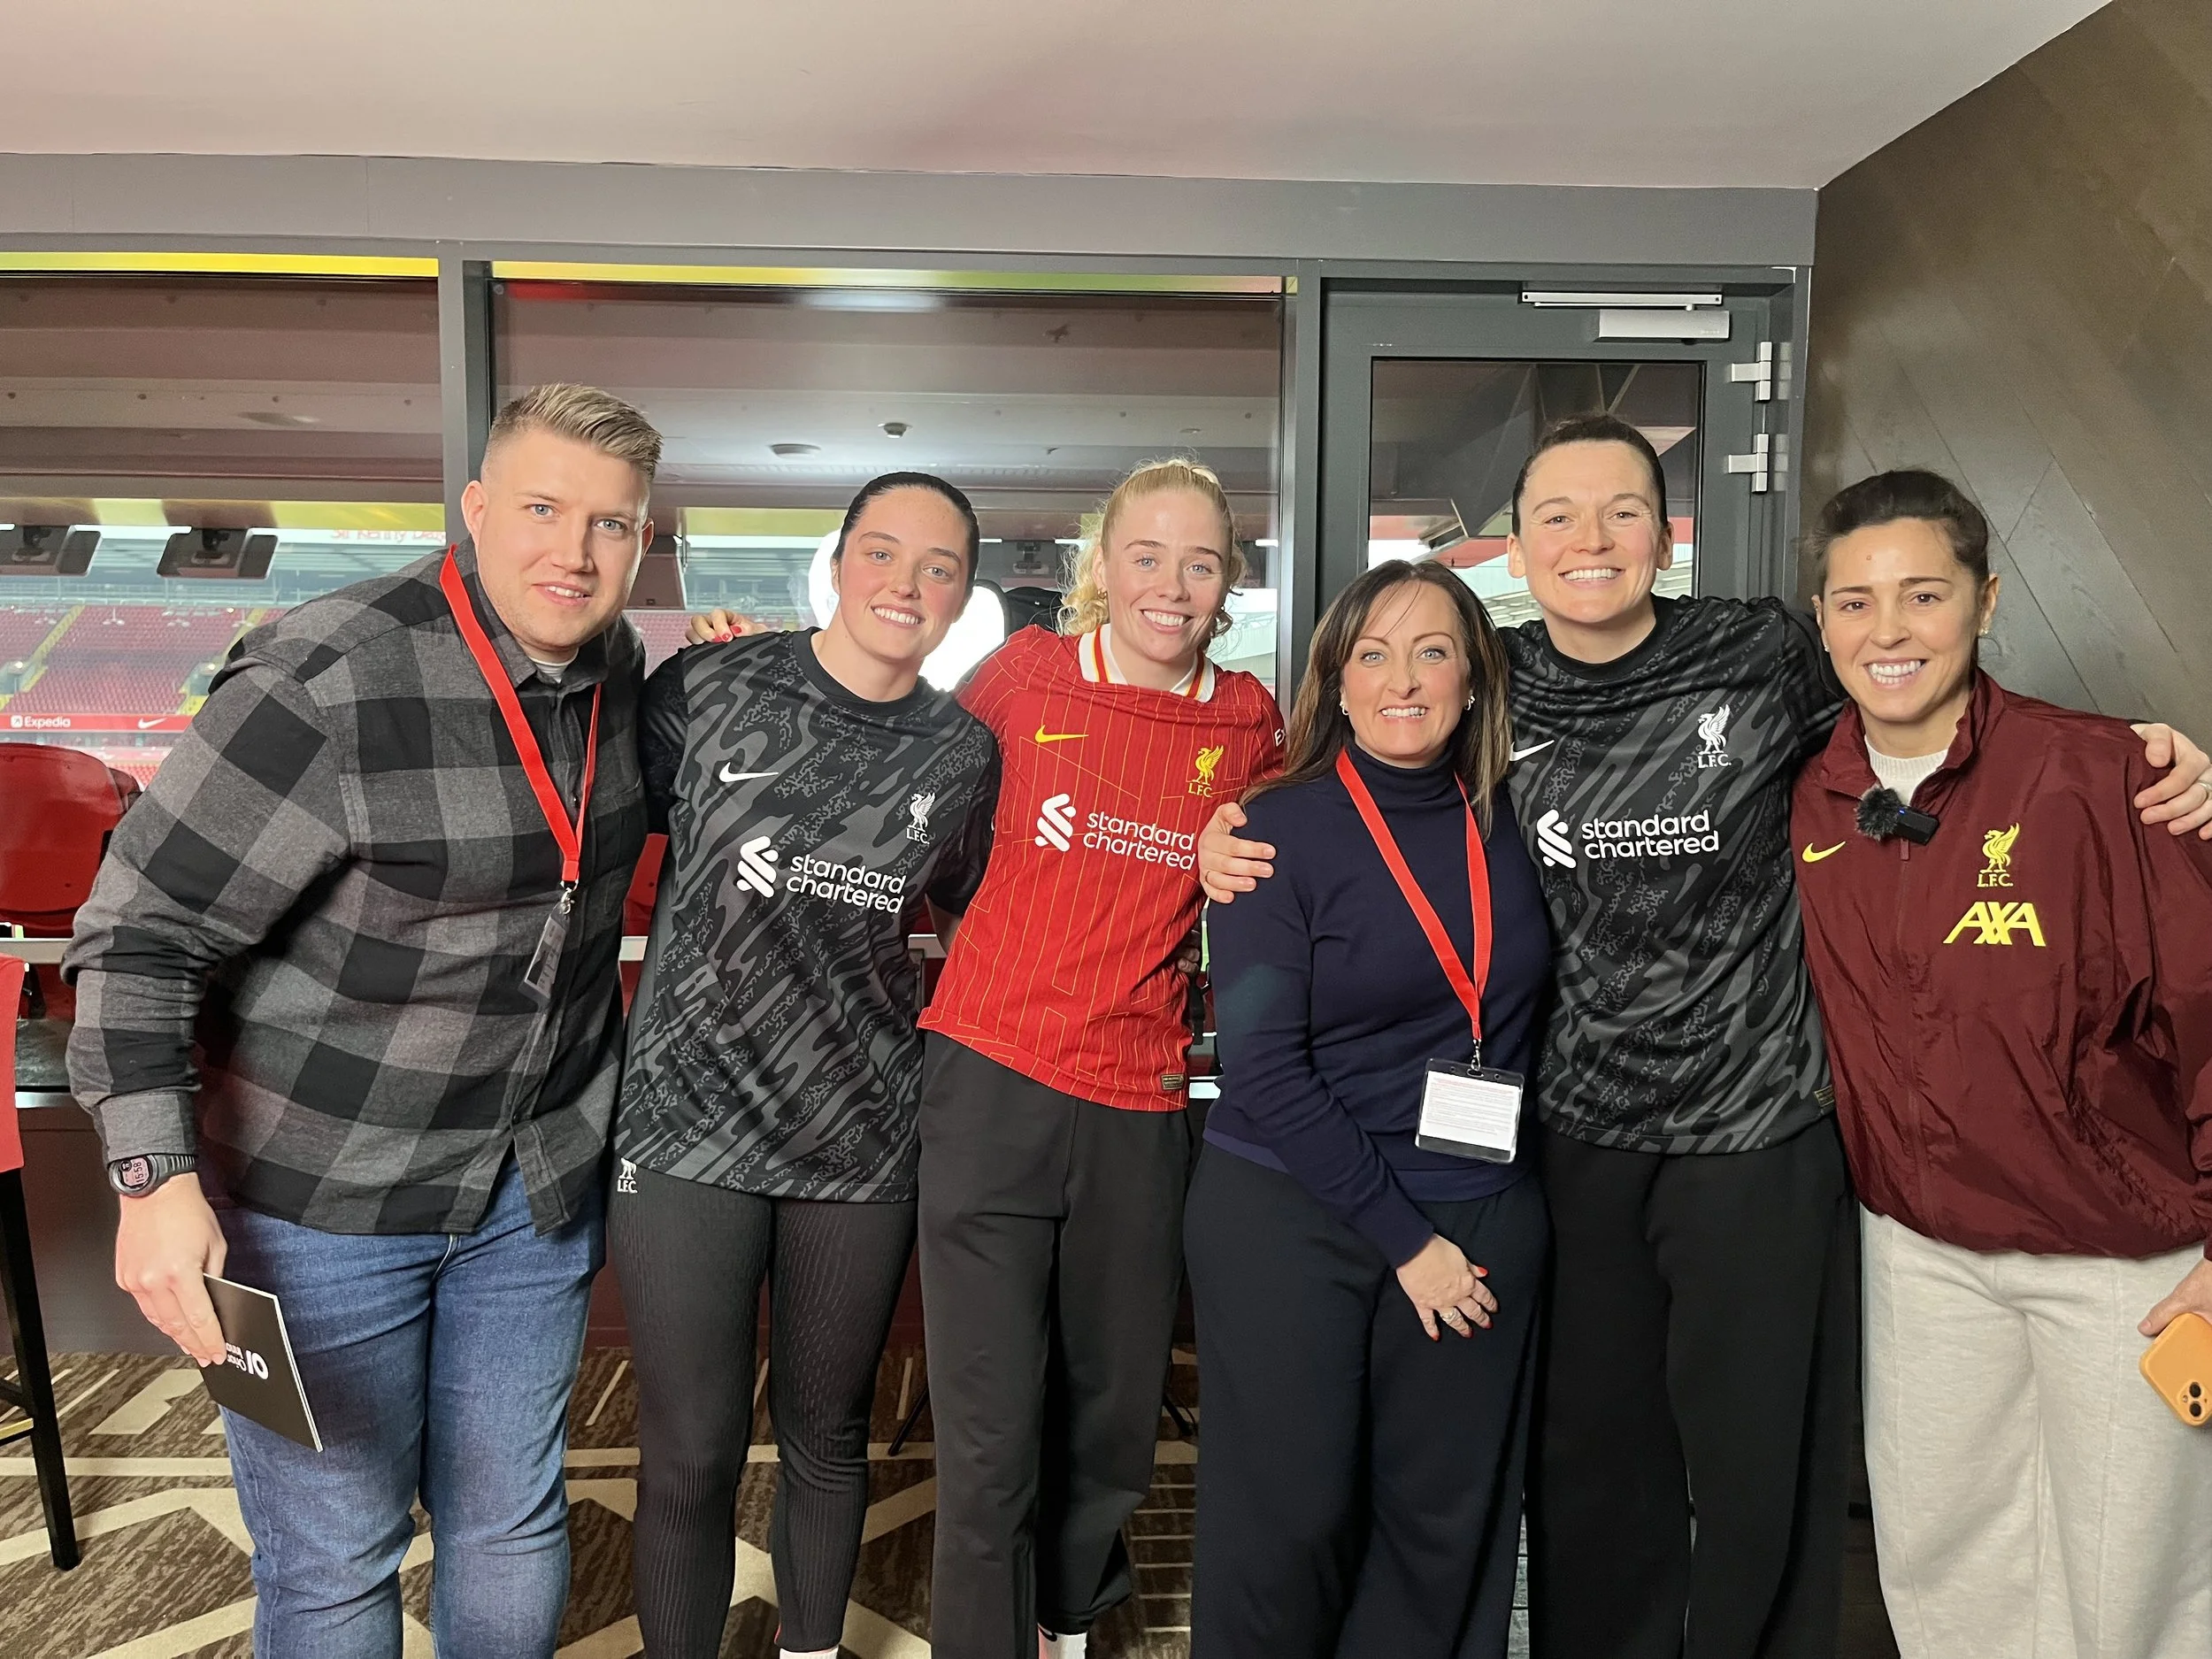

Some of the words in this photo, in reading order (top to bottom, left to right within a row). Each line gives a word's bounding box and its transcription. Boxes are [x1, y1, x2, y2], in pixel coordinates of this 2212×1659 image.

[24, 715, 71, 729] Expedia
[1697, 754, 1732, 769] L.F.C.
[1086, 810, 1195, 851] standard
[1581, 809, 1710, 839] standard
[1082, 831, 1196, 871] chartered
[1584, 830, 1720, 859] chartered
[789, 853, 907, 895] standard
[1977, 873, 2014, 887] L.F.C.
[786, 874, 904, 914] chartered
[1942, 901, 2047, 948] AXA
